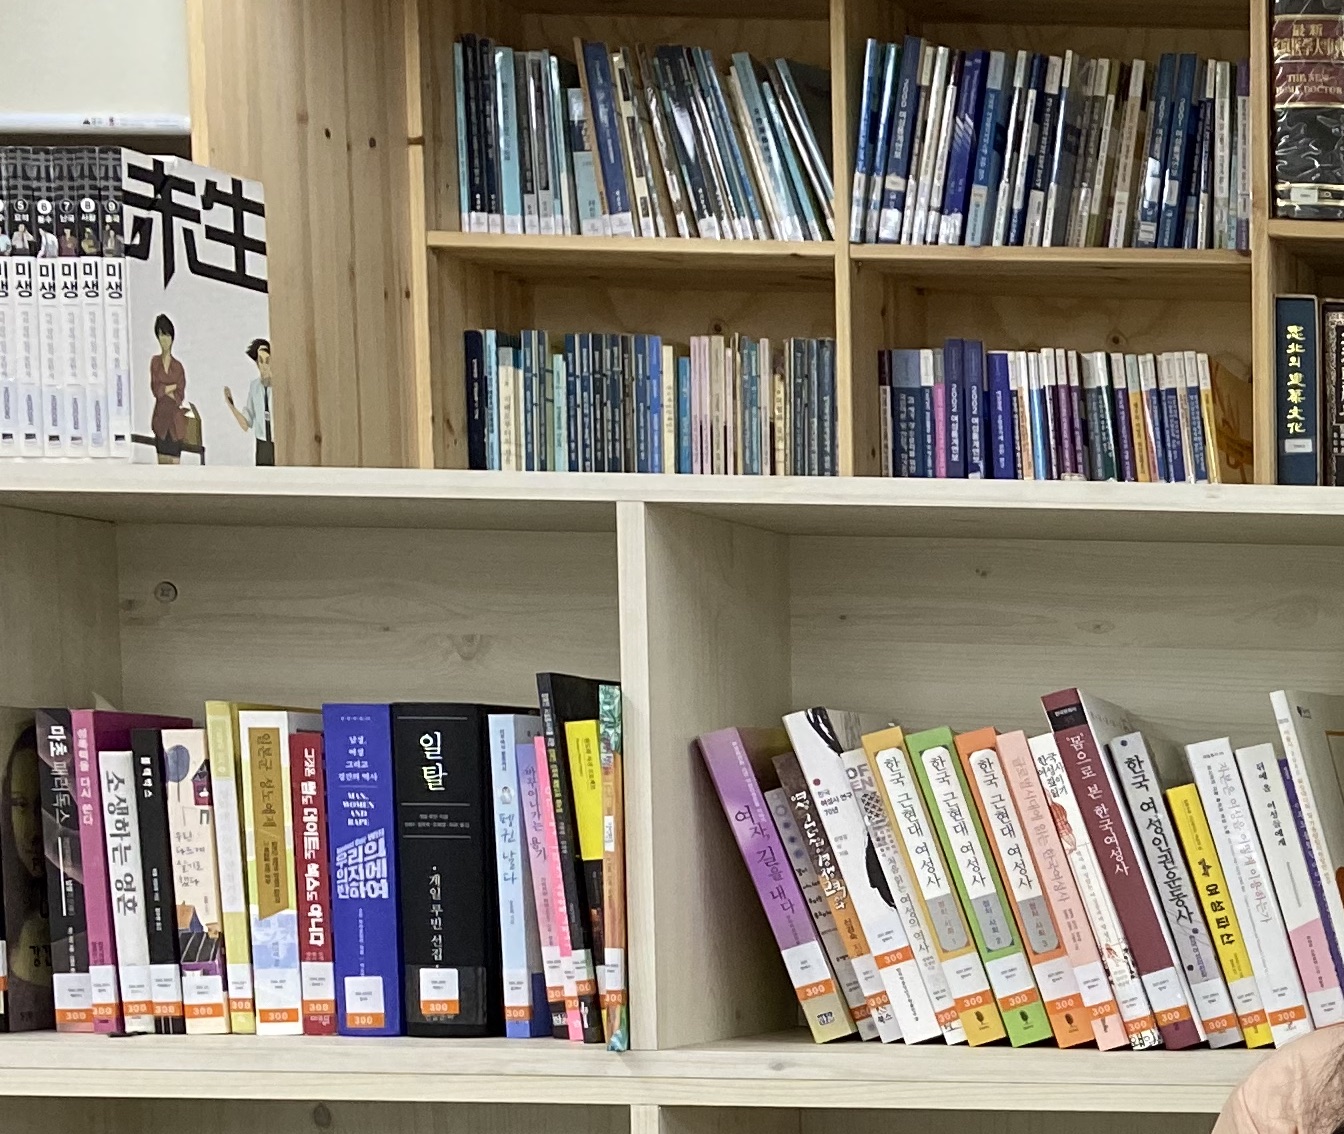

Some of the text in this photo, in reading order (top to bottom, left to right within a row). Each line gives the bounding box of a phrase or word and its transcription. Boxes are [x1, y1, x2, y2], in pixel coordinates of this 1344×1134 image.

[16, 261, 32, 297] 미생
[39, 263, 56, 299] 미생
[61, 262, 78, 298] 미생
[82, 261, 99, 298] 미생
[106, 262, 122, 299] 미생
[420, 731, 447, 790] 일탈
[300, 807, 320, 859] 데이트도
[884, 757, 942, 889] 한국 근현대 여성사
[930, 756, 986, 888] 한국 근현대 여성사
[976, 758, 1033, 889] 한국 근현대 여성사
[1124, 755, 1195, 925] 한국 여성인권운동사
[307, 904, 326, 947] 아니다
[884, 952, 903, 963] 300
[806, 984, 826, 996] 300
[963, 995, 983, 1007] 300
[1008, 994, 1028, 1005] 300
[1277, 1010, 1296, 1021] 300
